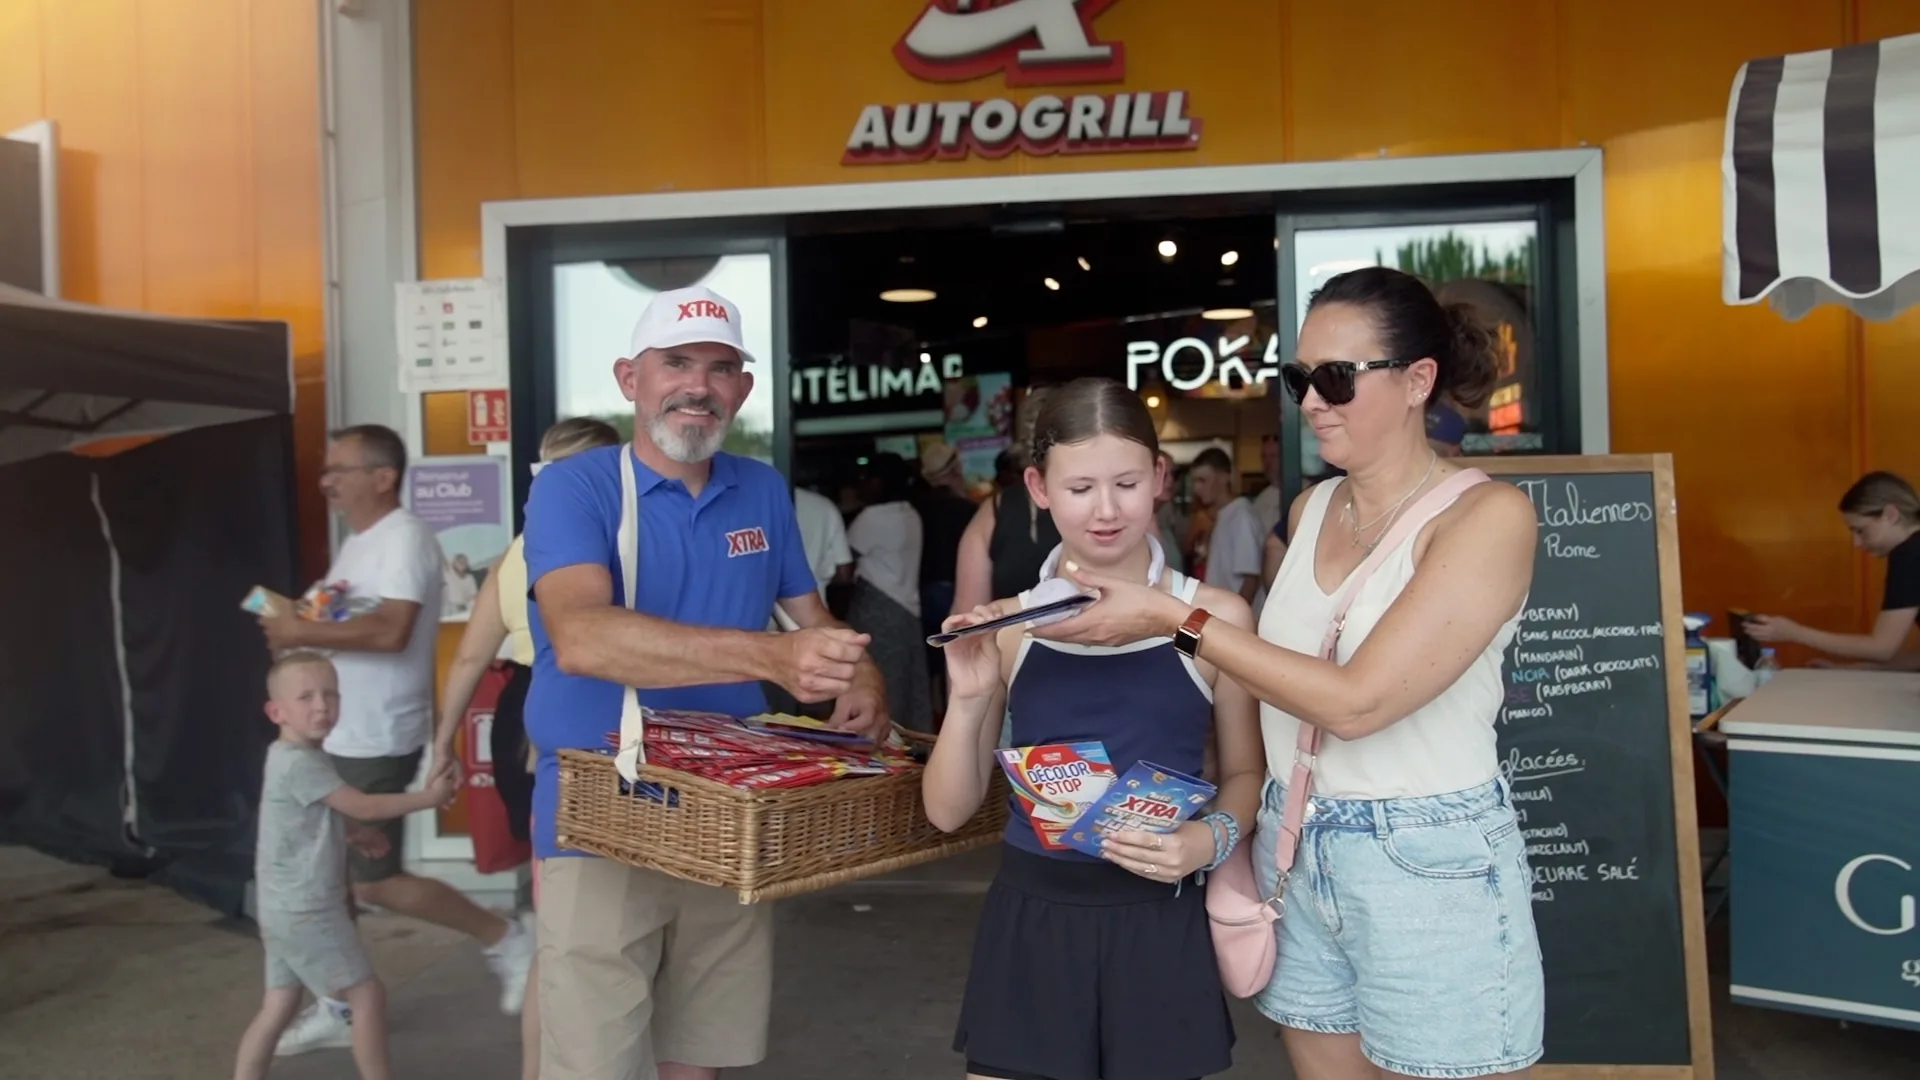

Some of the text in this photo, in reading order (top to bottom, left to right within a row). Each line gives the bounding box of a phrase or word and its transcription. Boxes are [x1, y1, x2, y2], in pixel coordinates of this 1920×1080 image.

[845, 91, 1192, 149] AUTOGRILL
[436, 482, 472, 497] Club
[1544, 533, 1600, 558] Rome
[1514, 643, 1584, 668] (MANDARIN)
[1511, 654, 1659, 683] NOIR (DARK CHOCOLATE)
[1536, 676, 1612, 703] (RASPBERRY)
[1502, 703, 1553, 725] (MANGO)
[1027, 762, 1090, 784] DÉCOLOR
[1045, 778, 1082, 796] STOP
[1597, 857, 1639, 881] SALÉ
